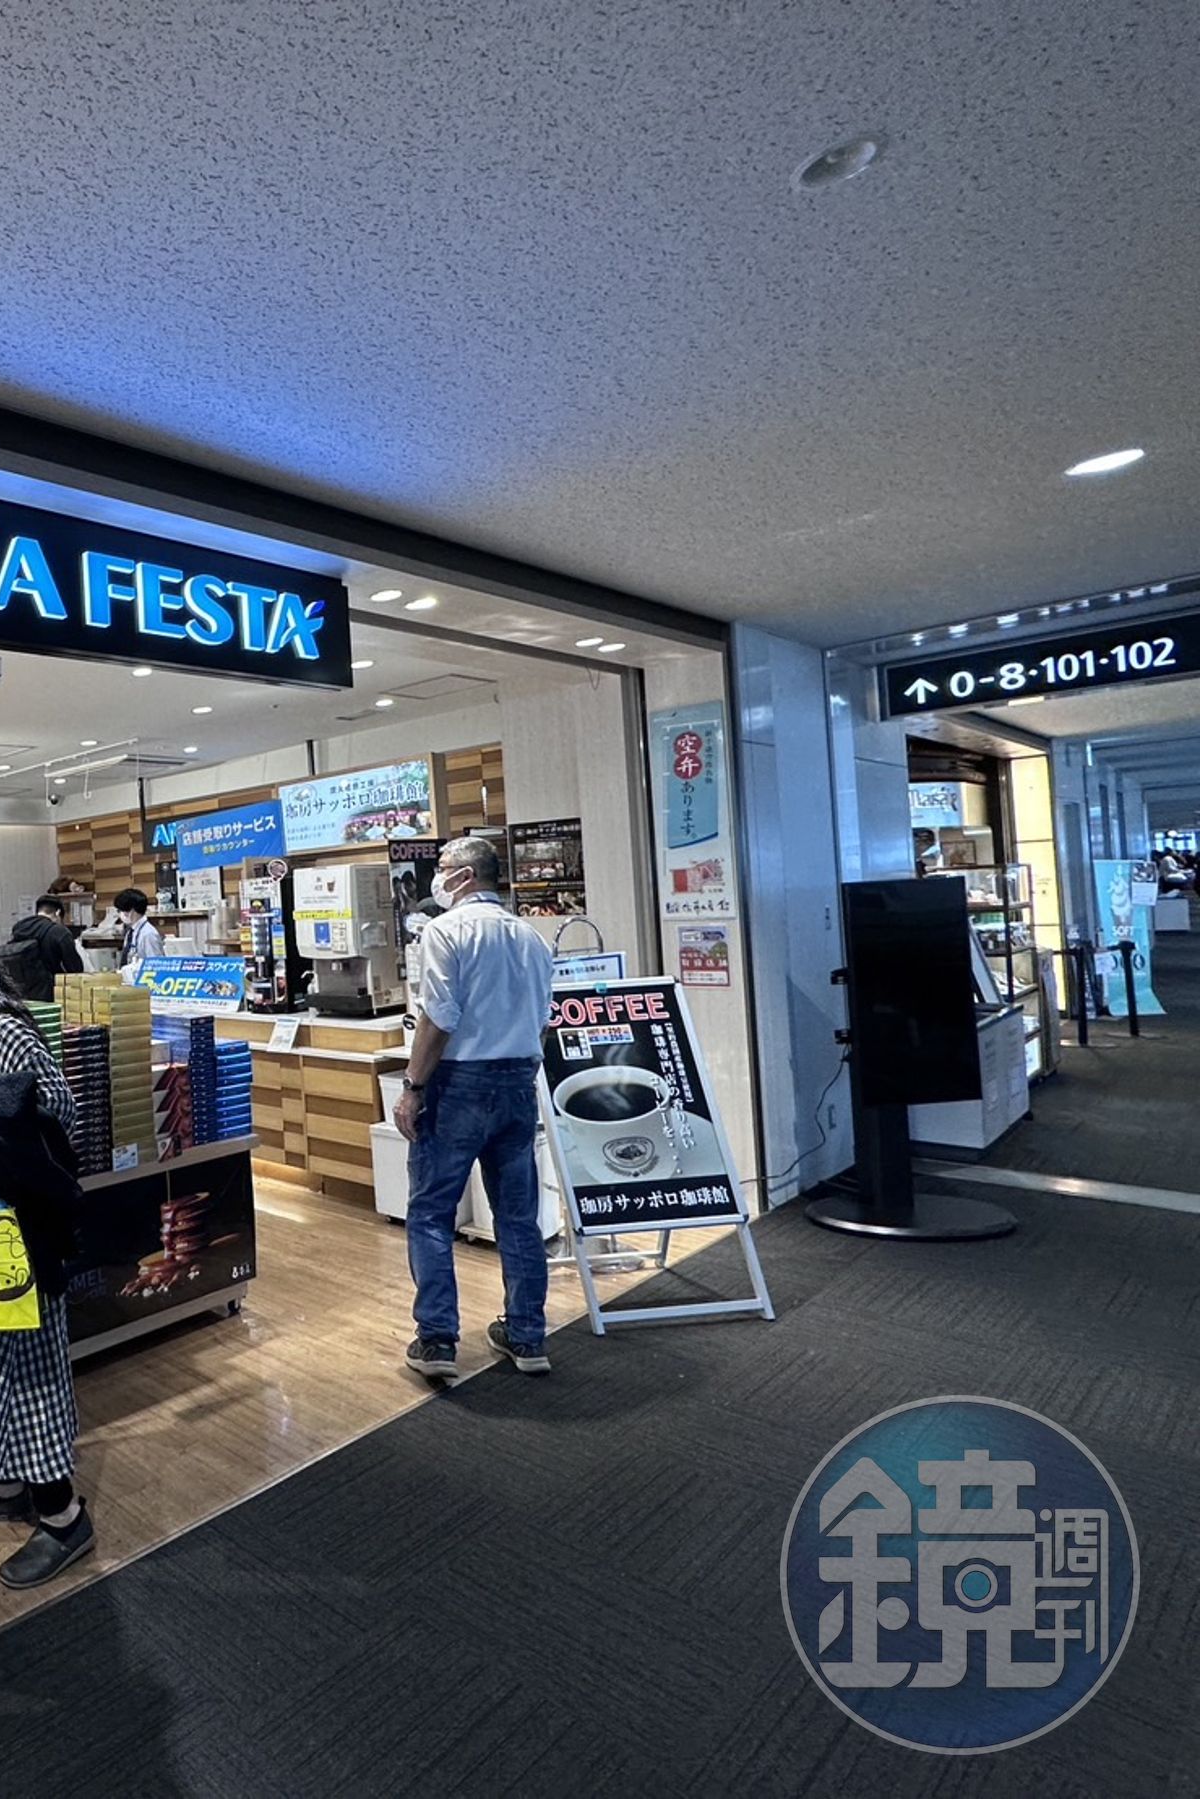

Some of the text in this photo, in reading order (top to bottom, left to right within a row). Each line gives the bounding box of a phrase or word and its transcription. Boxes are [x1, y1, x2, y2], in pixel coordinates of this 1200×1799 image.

[81, 551, 325, 660] FESTA
[390, 843, 437, 860] COFFEE
[1111, 925, 1135, 937] SOFT
[548, 993, 670, 1027] COFFEE
[580, 1185, 730, 1215] 珈房サッポロ珈琲館
